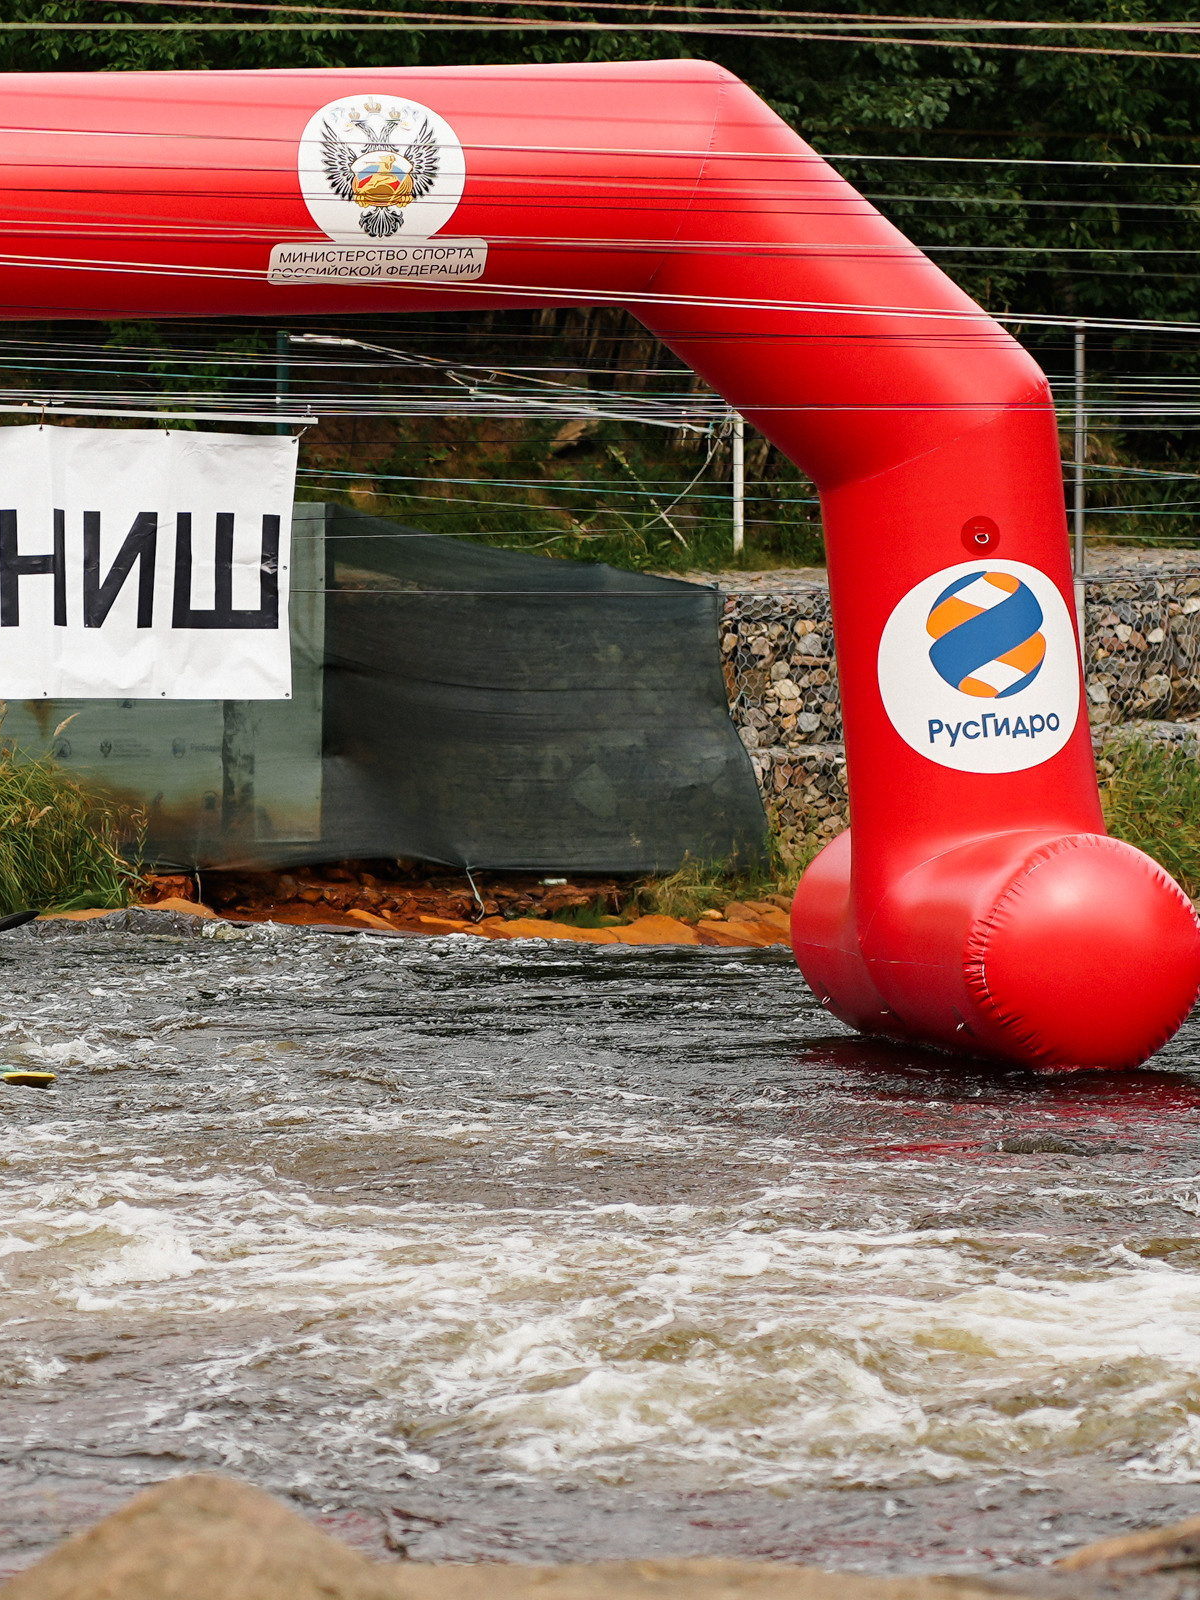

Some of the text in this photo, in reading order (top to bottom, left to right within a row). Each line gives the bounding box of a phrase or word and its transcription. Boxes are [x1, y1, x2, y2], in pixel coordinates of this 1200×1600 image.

[279, 248, 474, 263] МИНИСТЕРСТВО СПОРТА
[271, 263, 482, 279] РОССИЙСКОЙ ФЕДЕРАЦИИ
[928, 712, 1060, 747] РусГидро
